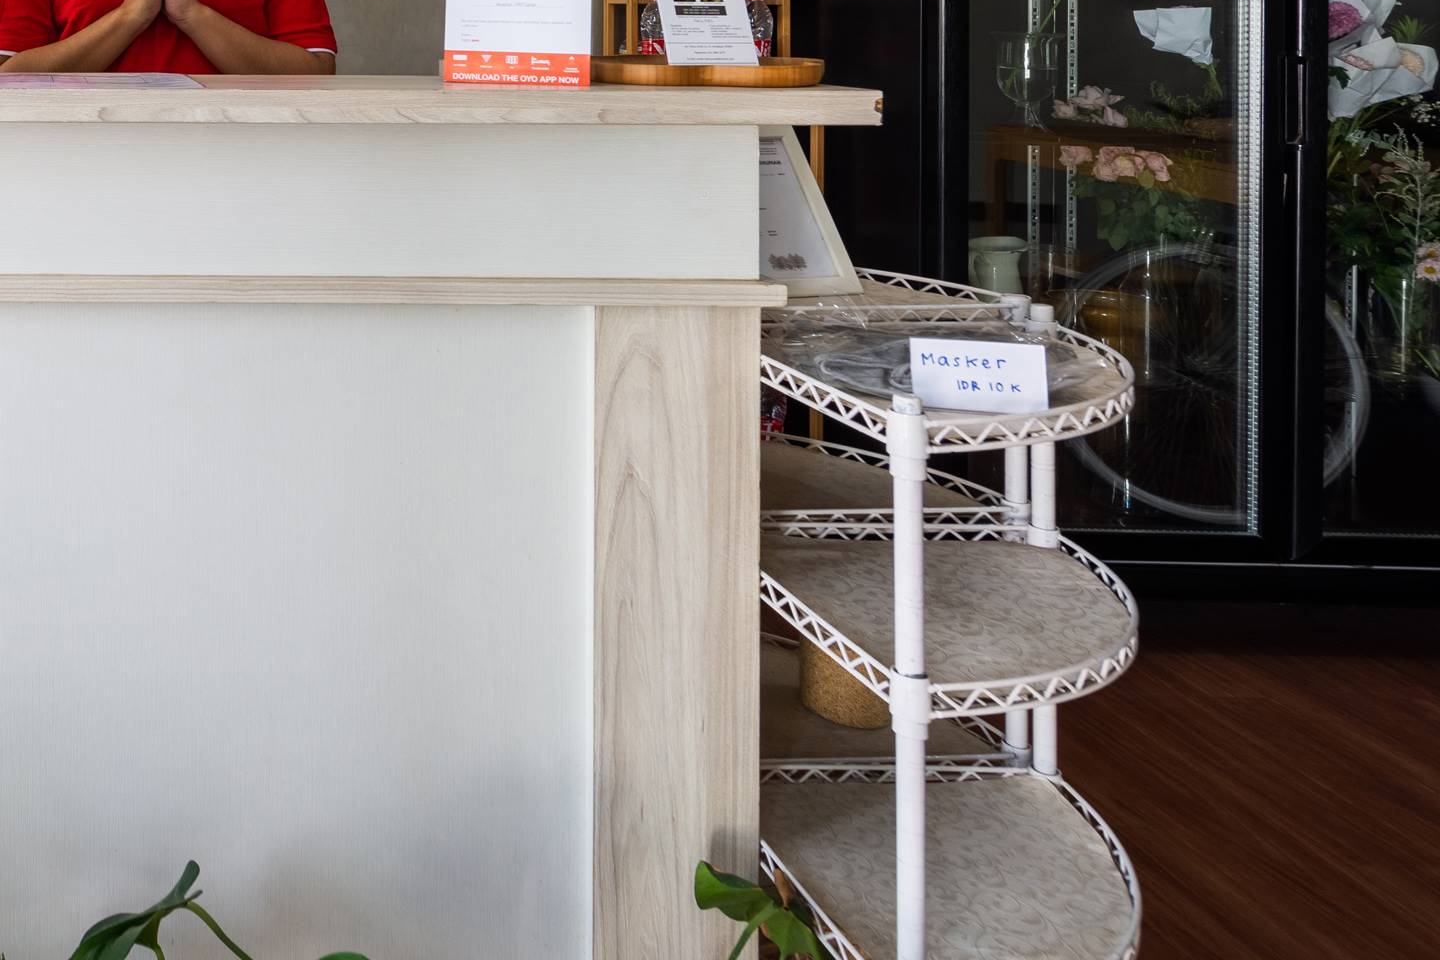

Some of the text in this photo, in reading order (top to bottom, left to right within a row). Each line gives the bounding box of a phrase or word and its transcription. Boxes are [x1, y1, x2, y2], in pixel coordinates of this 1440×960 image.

[452, 72, 500, 81] DOWNLOAD
[558, 76, 579, 84] NOW
[921, 352, 1007, 369] Masker
[957, 379, 1022, 393] IDR 10 K
